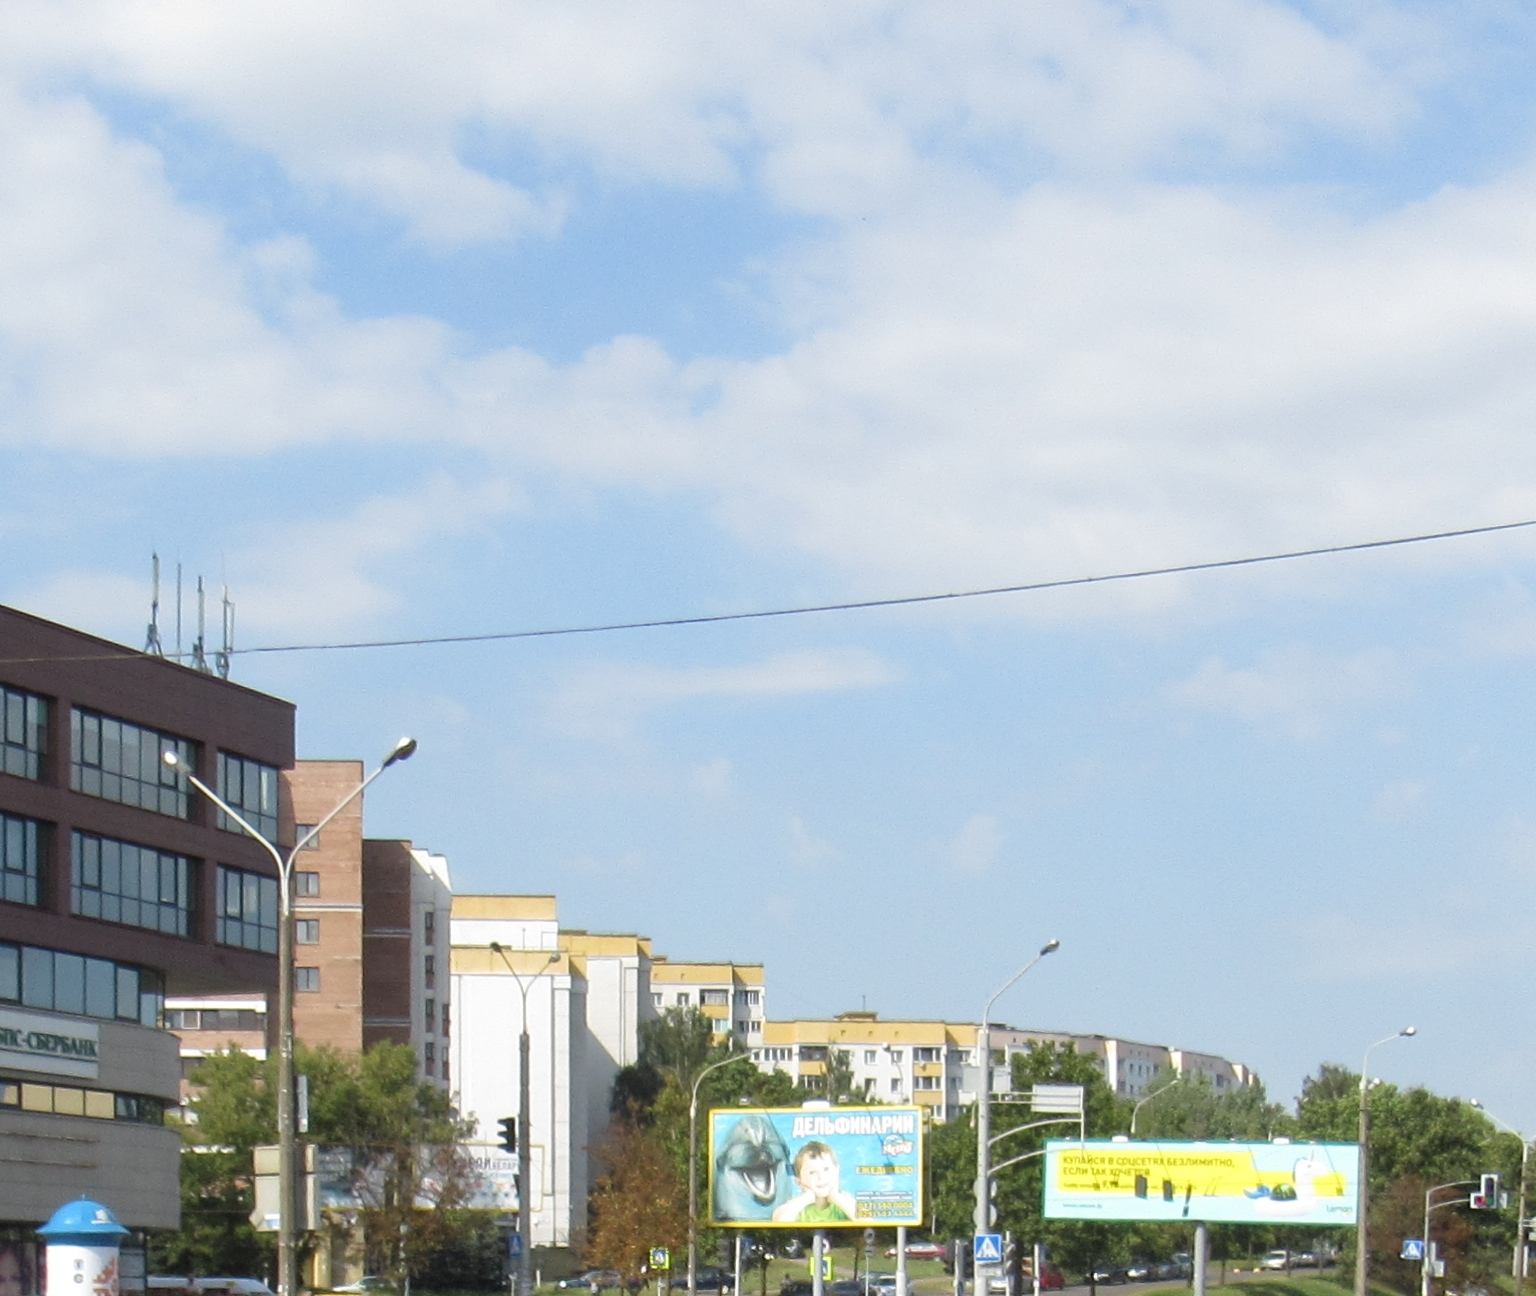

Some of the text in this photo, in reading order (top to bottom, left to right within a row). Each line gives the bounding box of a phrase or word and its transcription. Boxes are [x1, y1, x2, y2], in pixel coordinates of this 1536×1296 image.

[792, 1115, 914, 1139] ДЕЛЬФИНАРИЙ
[1063, 1155, 1235, 1168] КУПАЙСЯ В СОЦСЕТЯХ БЕЗЛИМИТНО,
[1109, 1168, 1151, 1177] ХОЧЕТСЯ
